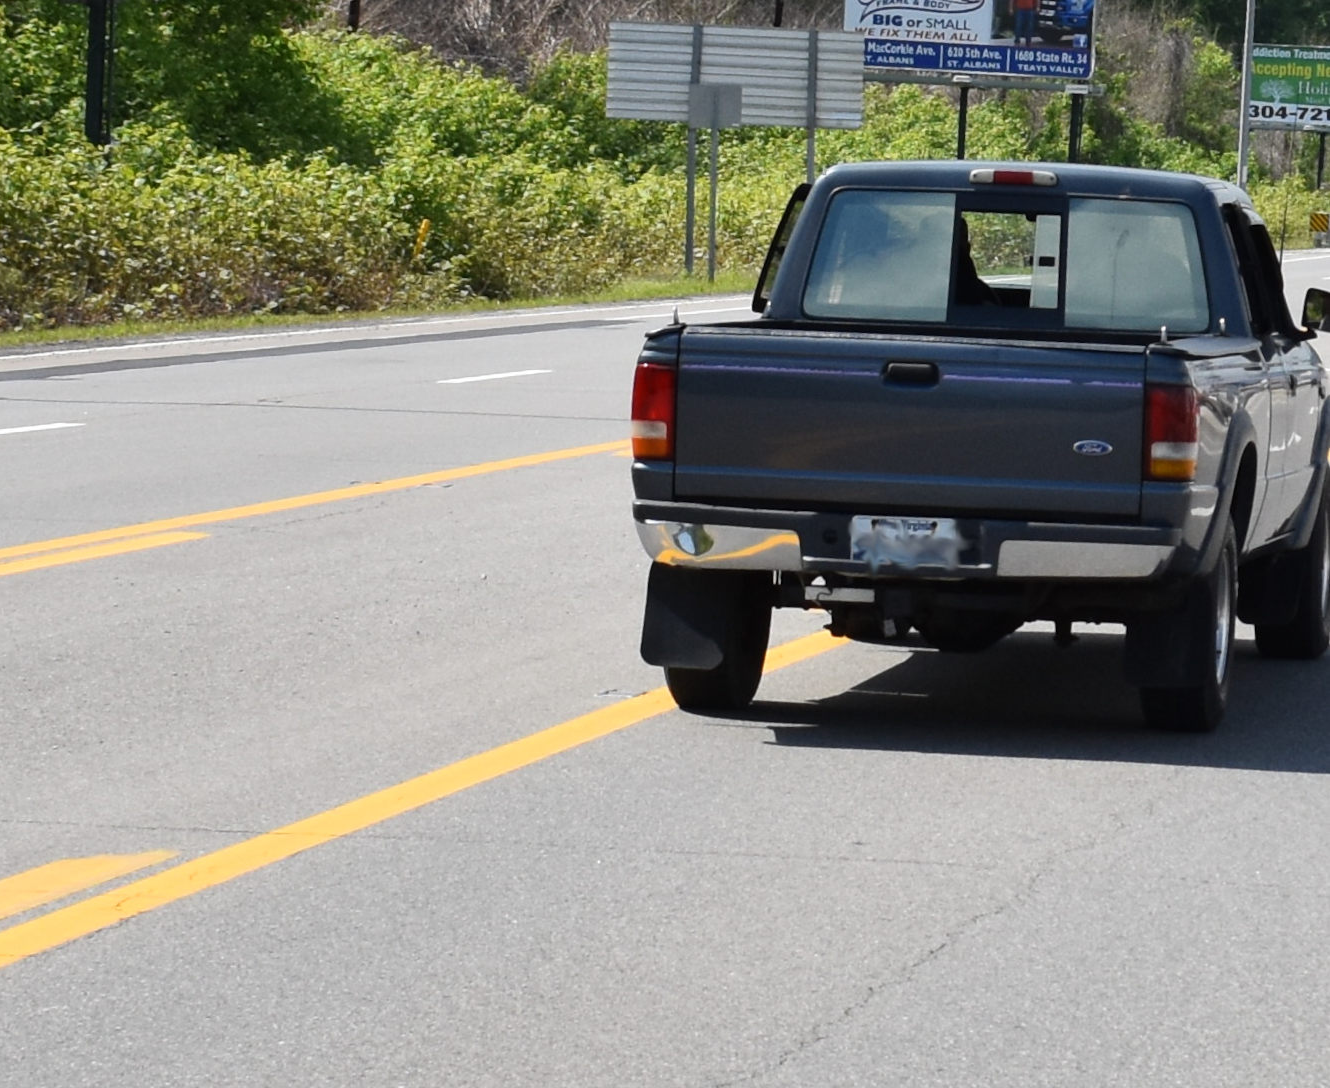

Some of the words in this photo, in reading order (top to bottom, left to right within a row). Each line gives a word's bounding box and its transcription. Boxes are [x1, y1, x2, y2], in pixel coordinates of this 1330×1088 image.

[923, 0, 951, 9] BODY
[872, 14, 903, 27] BIG
[906, 18, 923, 29] or
[926, 17, 972, 31] SMALL
[879, 27, 900, 38] FIX
[905, 29, 945, 41] THEM
[867, 41, 914, 55] MacCorkle
[915, 44, 936, 57] Ave.
[965, 47, 980, 59] 5th
[981, 48, 1003, 60] Ave.
[1252, 47, 1291, 59] ddiction
[877, 56, 915, 65] ALBANS
[1036, 51, 1060, 63] State
[1076, 53, 1088, 65] 34
[947, 59, 962, 68] ST.
[963, 61, 1001, 70] ALBANS
[1017, 63, 1048, 73] TEAYS
[1049, 64, 1085, 75] VALLEY
